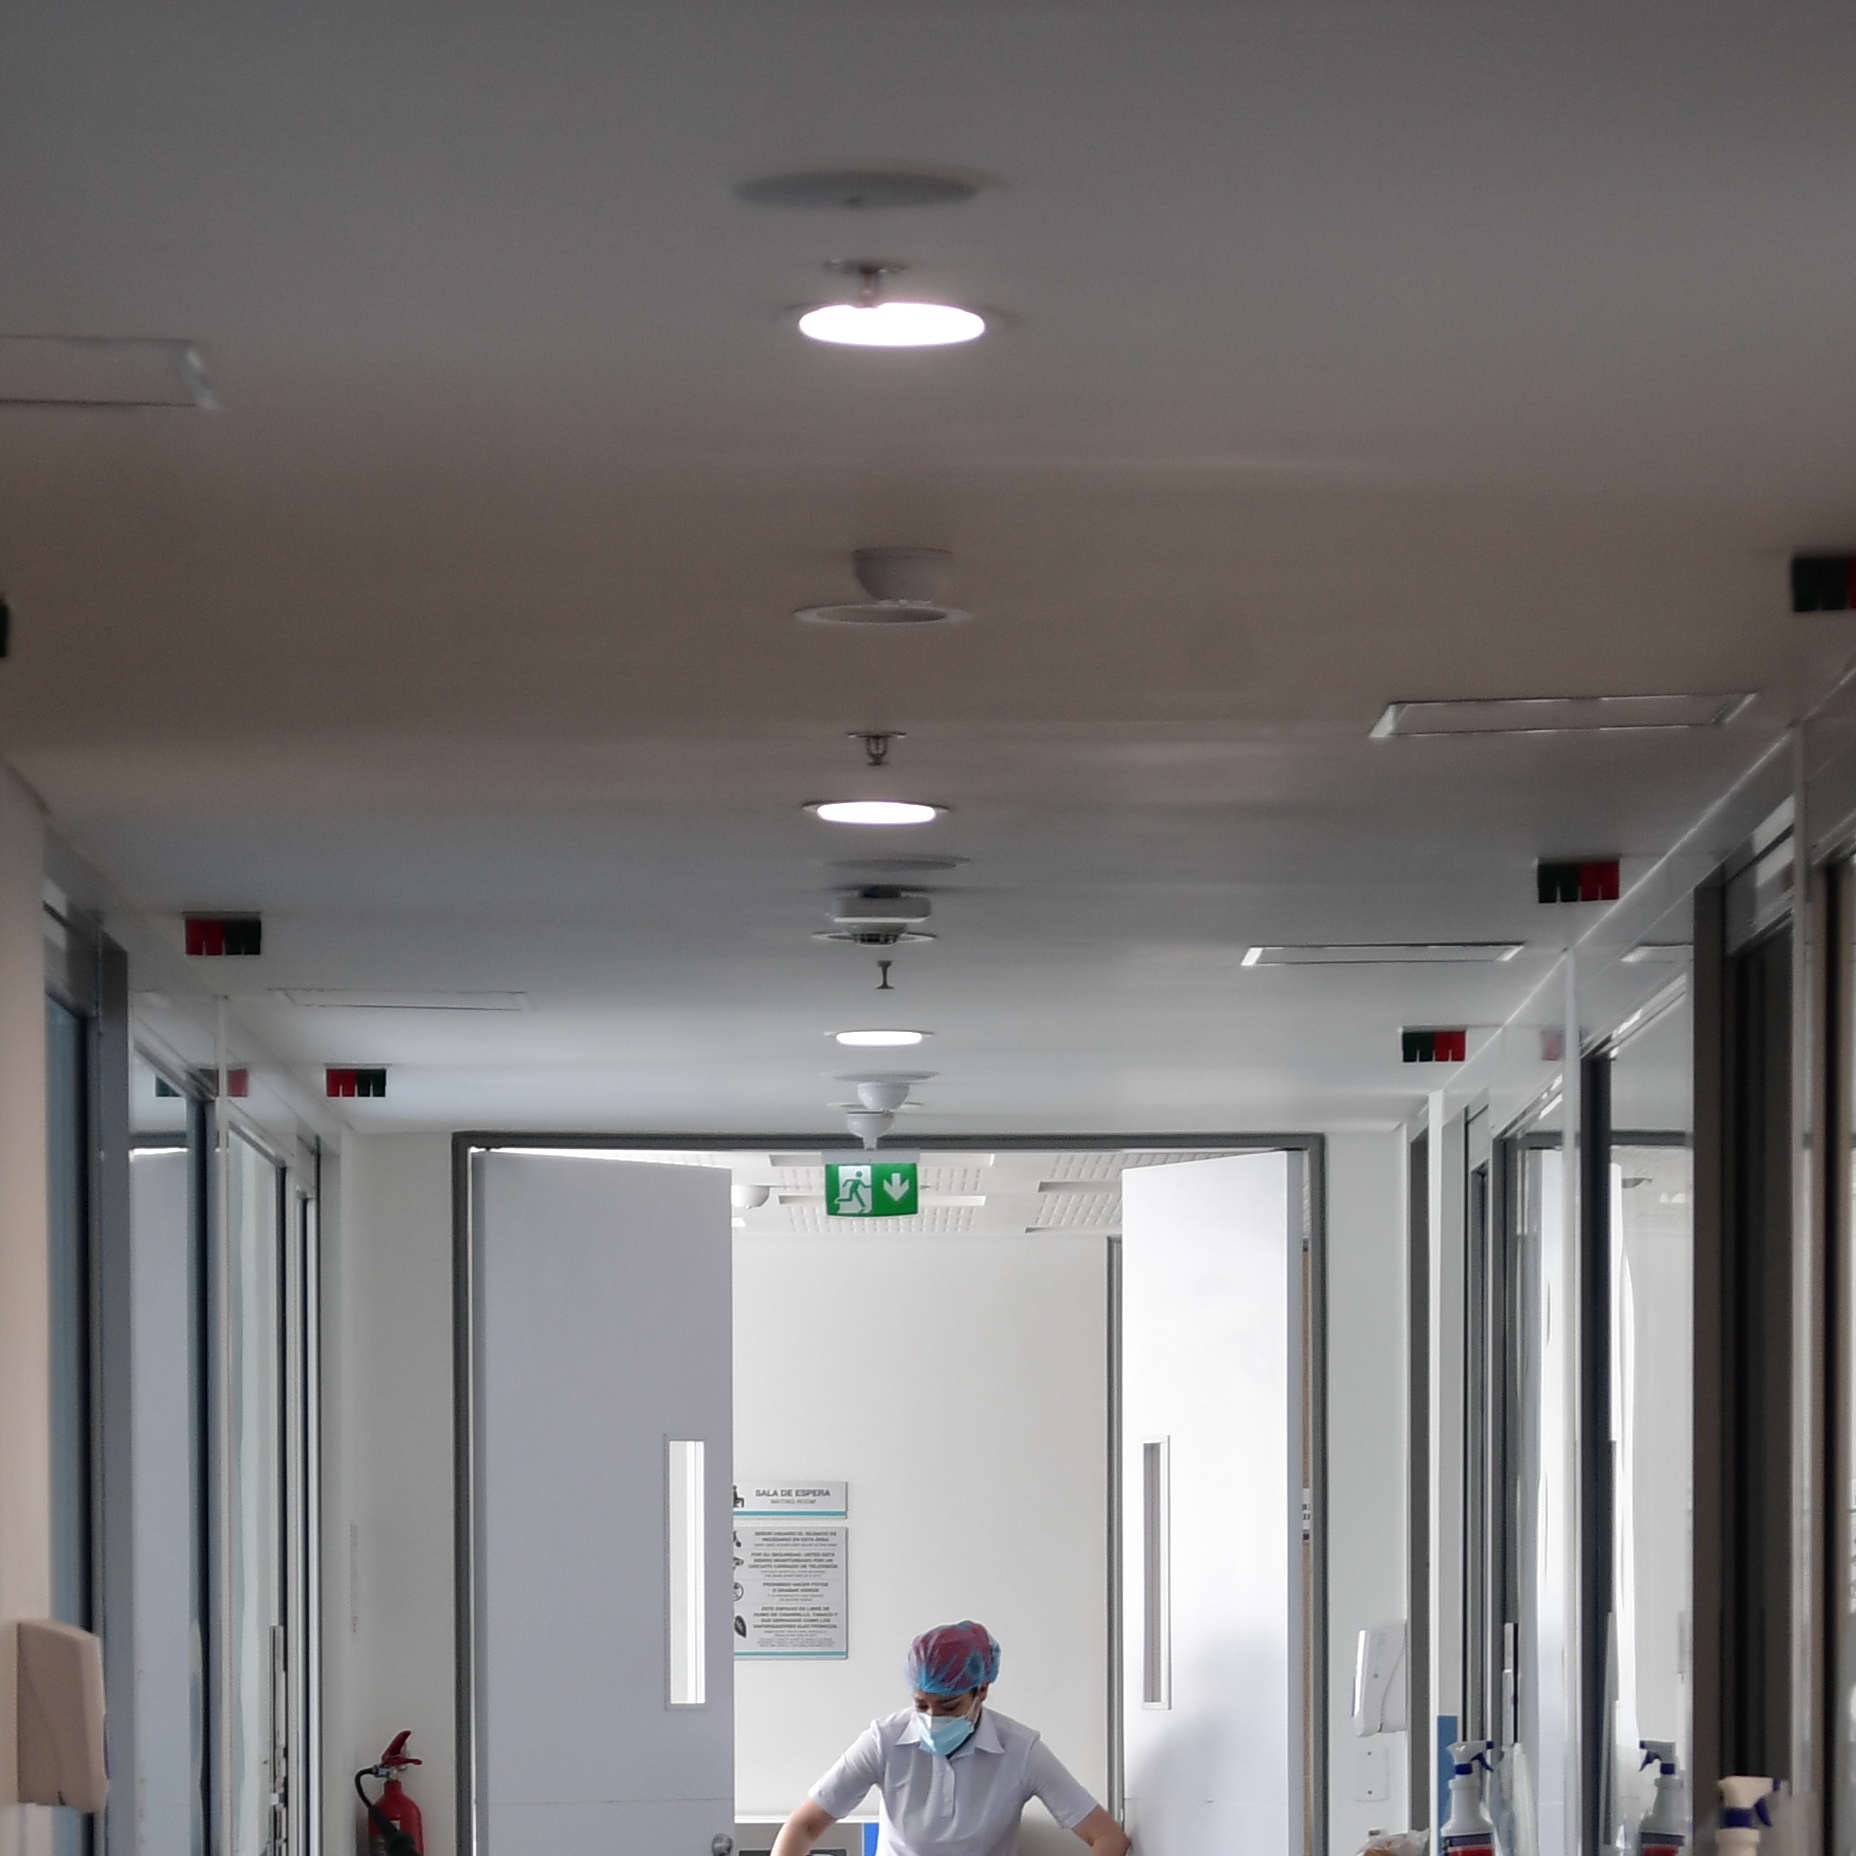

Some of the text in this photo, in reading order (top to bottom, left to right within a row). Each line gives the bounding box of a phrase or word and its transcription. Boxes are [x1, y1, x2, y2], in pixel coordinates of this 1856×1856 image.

[755, 1489, 831, 1497] SALA DE ESPERA
